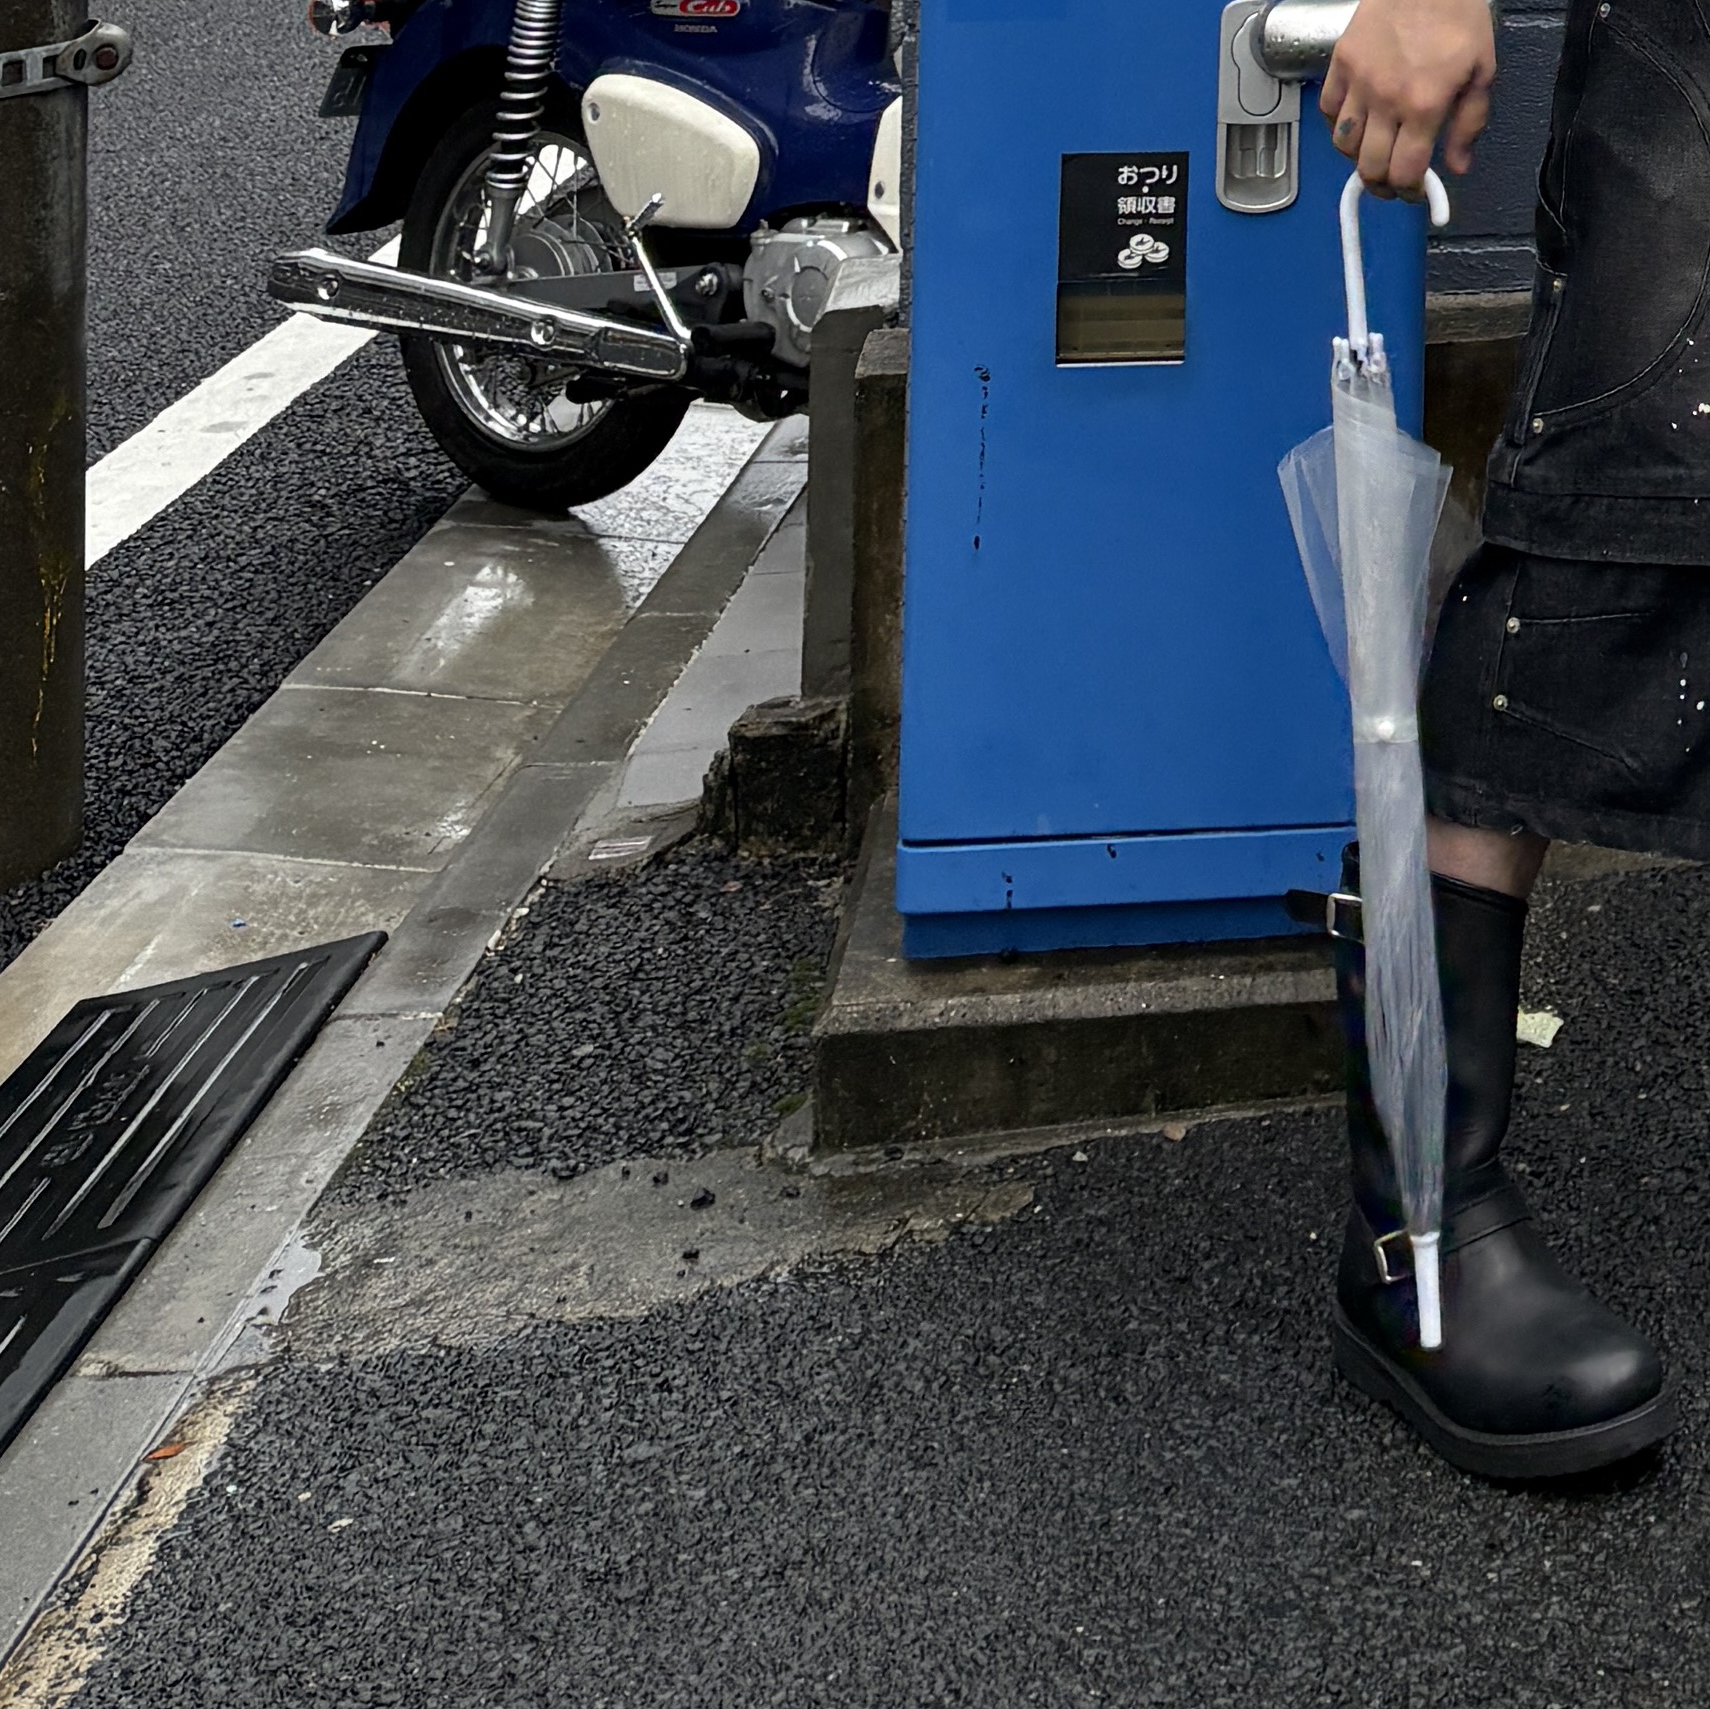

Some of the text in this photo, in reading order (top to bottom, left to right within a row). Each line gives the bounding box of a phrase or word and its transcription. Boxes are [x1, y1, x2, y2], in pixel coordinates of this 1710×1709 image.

[1117, 165, 1178, 185] おつり
[1117, 196, 1176, 214] 領収書
